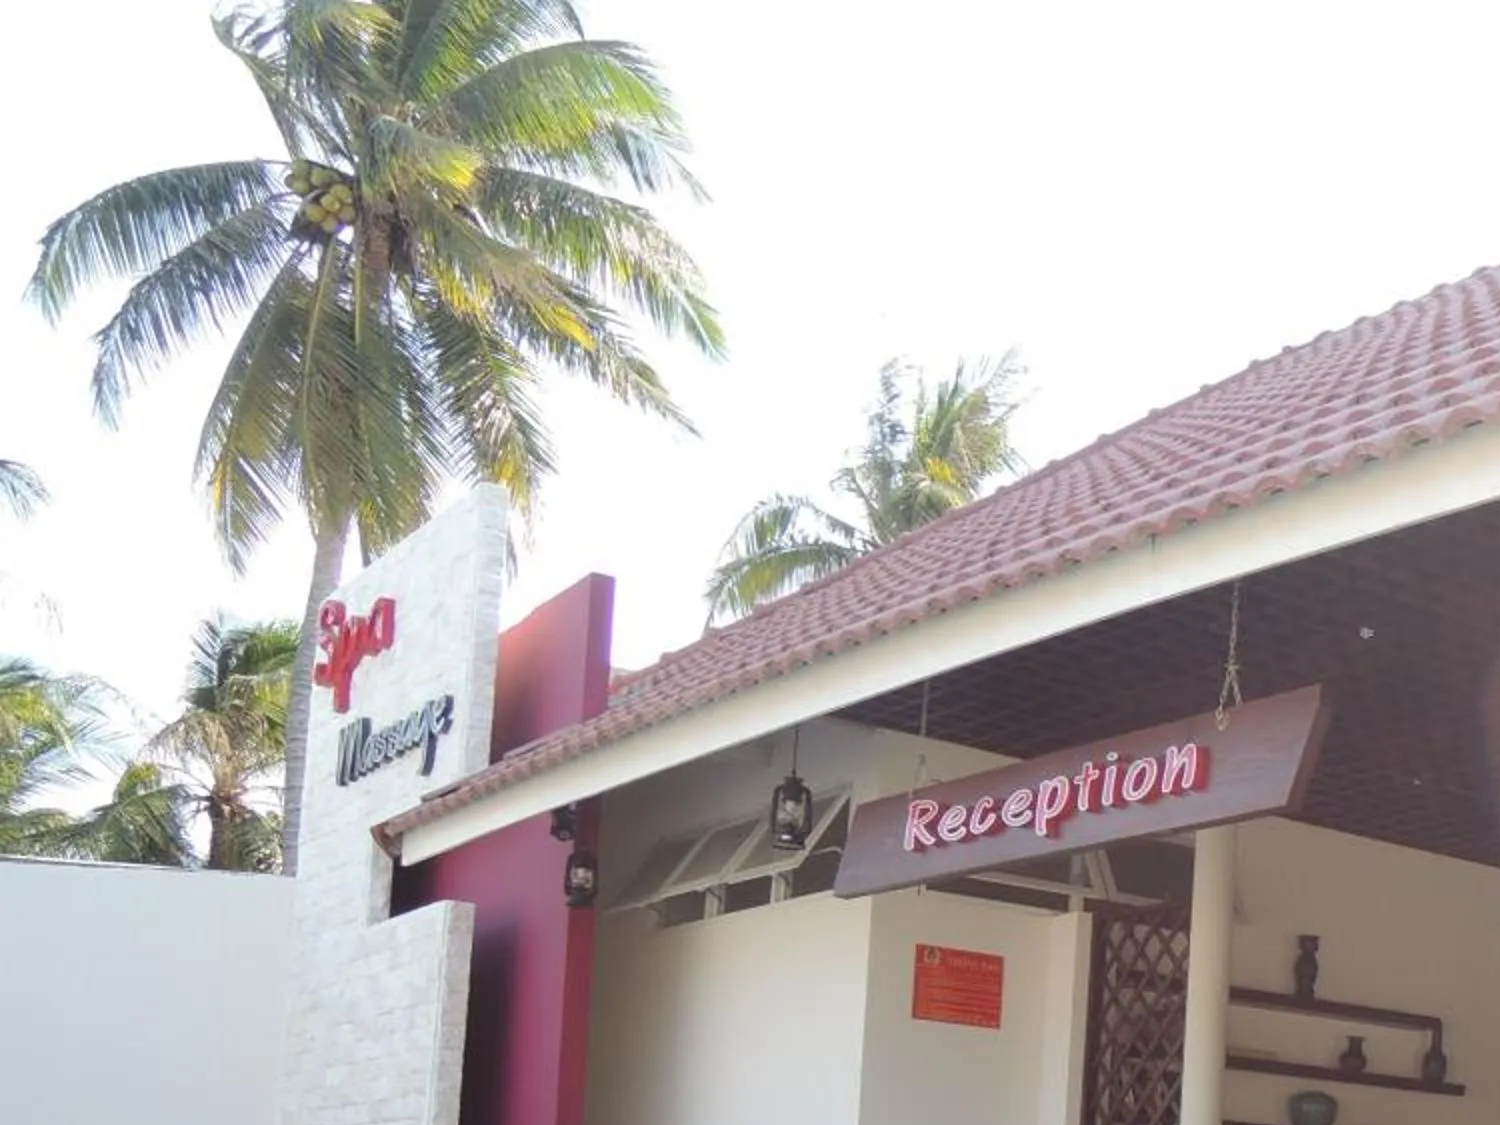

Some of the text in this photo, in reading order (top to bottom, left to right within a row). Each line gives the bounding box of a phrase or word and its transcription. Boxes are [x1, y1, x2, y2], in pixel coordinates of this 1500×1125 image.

[314, 596, 396, 713] Spa
[336, 694, 454, 787] Massage
[903, 743, 1209, 852] Reception
